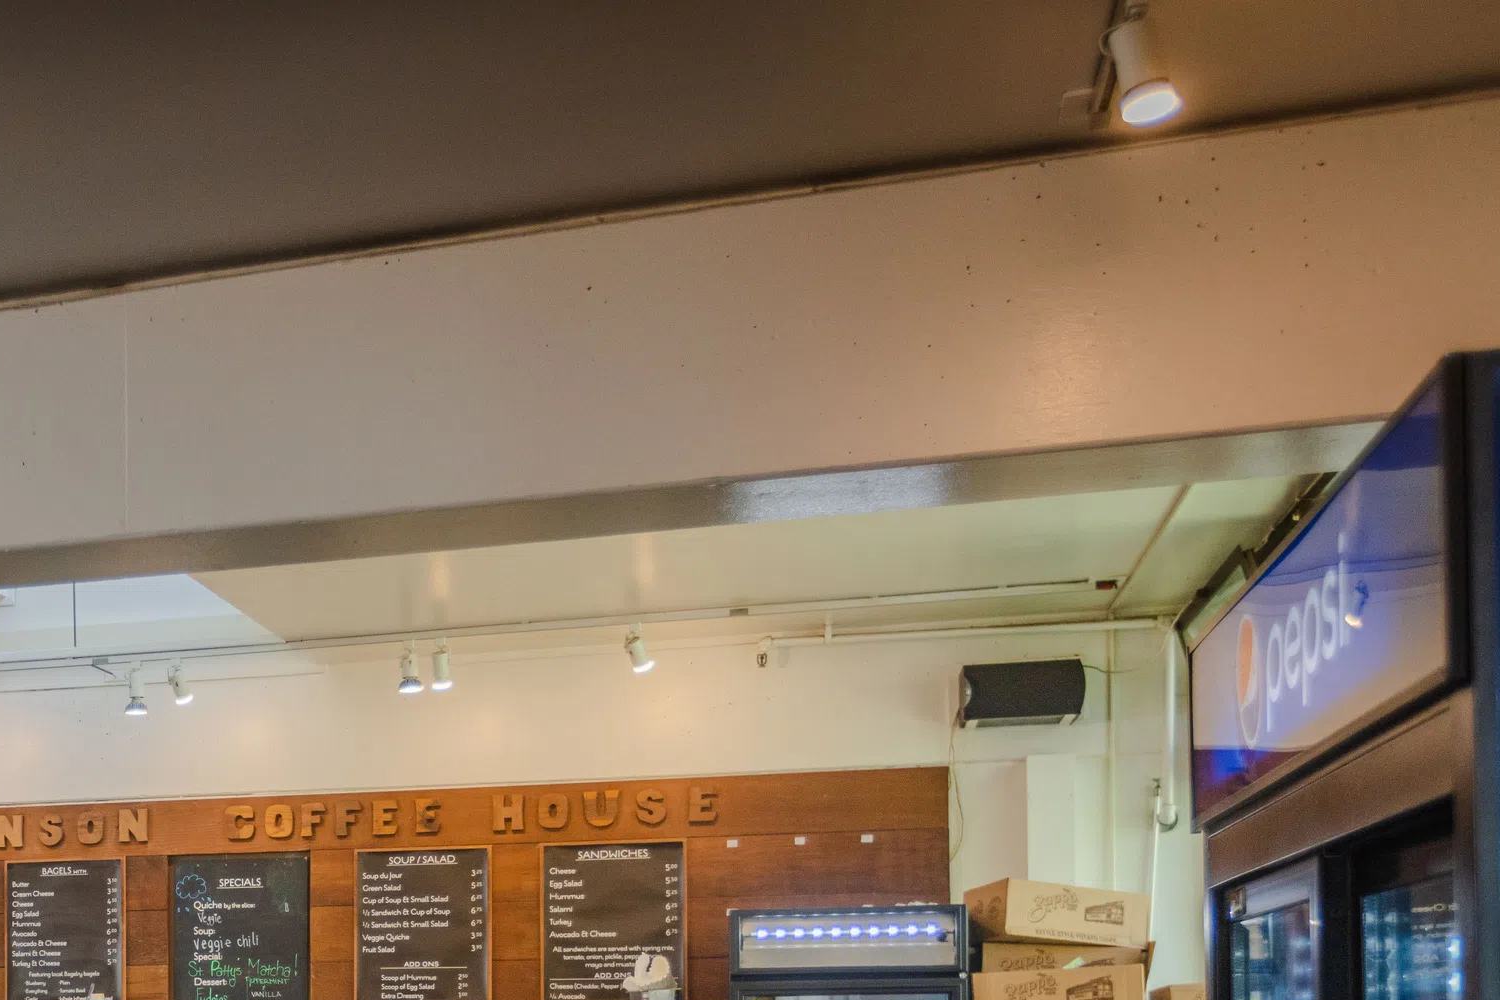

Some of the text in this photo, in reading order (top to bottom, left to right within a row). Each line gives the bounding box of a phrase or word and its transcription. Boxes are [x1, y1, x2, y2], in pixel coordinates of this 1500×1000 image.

[1264, 531, 1350, 732] pepsi
[223, 798, 443, 841] COFFEE
[491, 786, 719, 838] HOUSE
[577, 849, 648, 860] SANDWICHES
[388, 856, 415, 865] SOUP
[422, 854, 456, 863] SALAD
[41, 866, 72, 875] BAGELS
[549, 867, 576, 875] Cheese
[388, 872, 403, 881] Jour
[219, 878, 262, 888] SPECIALS
[549, 879, 583, 890] Egg Salad
[362, 884, 402, 892] Green Salad
[362, 897, 377, 905] Cup
[377, 896, 385, 904] of
[384, 896, 402, 905] Soup
[430, 895, 449, 903] Salad
[193, 900, 223, 912] Quiche
[223, 902, 231, 910] by
[23, 910, 40, 918] Salad
[370, 908, 402, 916] Sandwich
[410, 908, 425, 917] Cup
[433, 908, 451, 916] Soup
[197, 912, 222, 927] Veggie
[549, 918, 572, 927] Turkey
[370, 921, 402, 929] Sandwich
[410, 920, 429, 928] Small
[430, 920, 449, 928] Salad
[193, 926, 216, 936] Soup:
[589, 930, 617, 938] Cheese
[1035, 928, 1055, 936] KETTLE
[1056, 930, 1073, 939] STYLE
[1075, 932, 1098, 942] POTATO
[193, 931, 259, 954] veggie chili
[362, 933, 410, 943] Veggie Quiche
[642, 945, 661, 954] spring
[661, 944, 675, 952] mix,
[193, 952, 223, 962] Special:
[604, 953, 624, 962] pickle,
[584, 962, 603, 970] mayo
[188, 960, 204, 977] St.
[210, 957, 243, 987] Patty's
[193, 977, 228, 986] Dessert:
[381, 974, 399, 982] Scoop
[406, 984, 418, 992] Egg
[600, 983, 620, 991] Pepper
[251, 990, 282, 998] VANILLA
[396, 992, 424, 1000] Dressing
